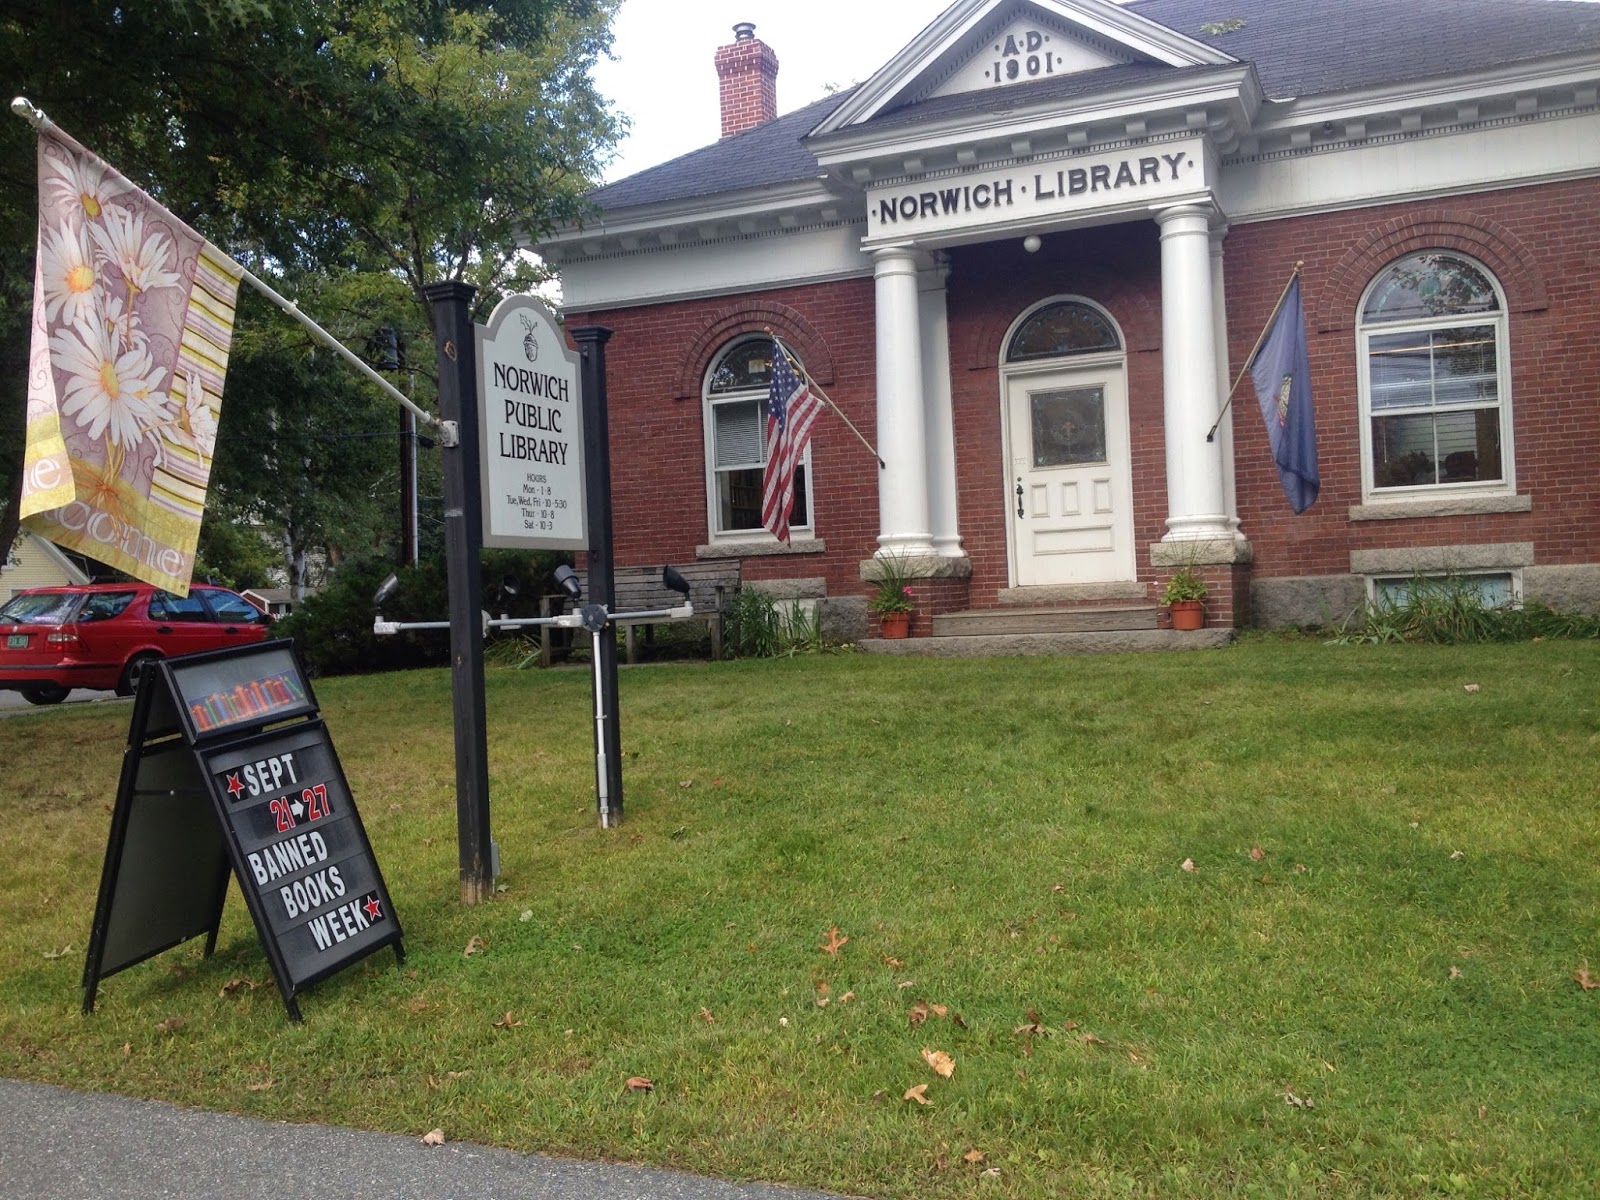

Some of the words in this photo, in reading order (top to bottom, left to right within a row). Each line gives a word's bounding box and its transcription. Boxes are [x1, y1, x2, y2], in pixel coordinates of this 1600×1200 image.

[994, 52, 1053, 83] 1901
[880, 179, 1013, 224] NORWICH
[1034, 152, 1187, 201] LIBRARY
[494, 362, 569, 402] NORWICH
[504, 399, 562, 433] PUBLIC
[499, 432, 568, 465] LIBRARY
[522, 484, 535, 494] Mon
[526, 473, 547, 483] HOURS
[521, 507, 535, 518] Thur
[532, 497, 541, 507] Fri
[524, 519, 534, 530] Sat
[243, 753, 298, 796] SEPT
[269, 796, 297, 833] 21
[302, 783, 331, 821] 27
[248, 831, 328, 886] BANNED
[280, 866, 347, 919] BOOKS
[307, 899, 370, 951] WEEK
